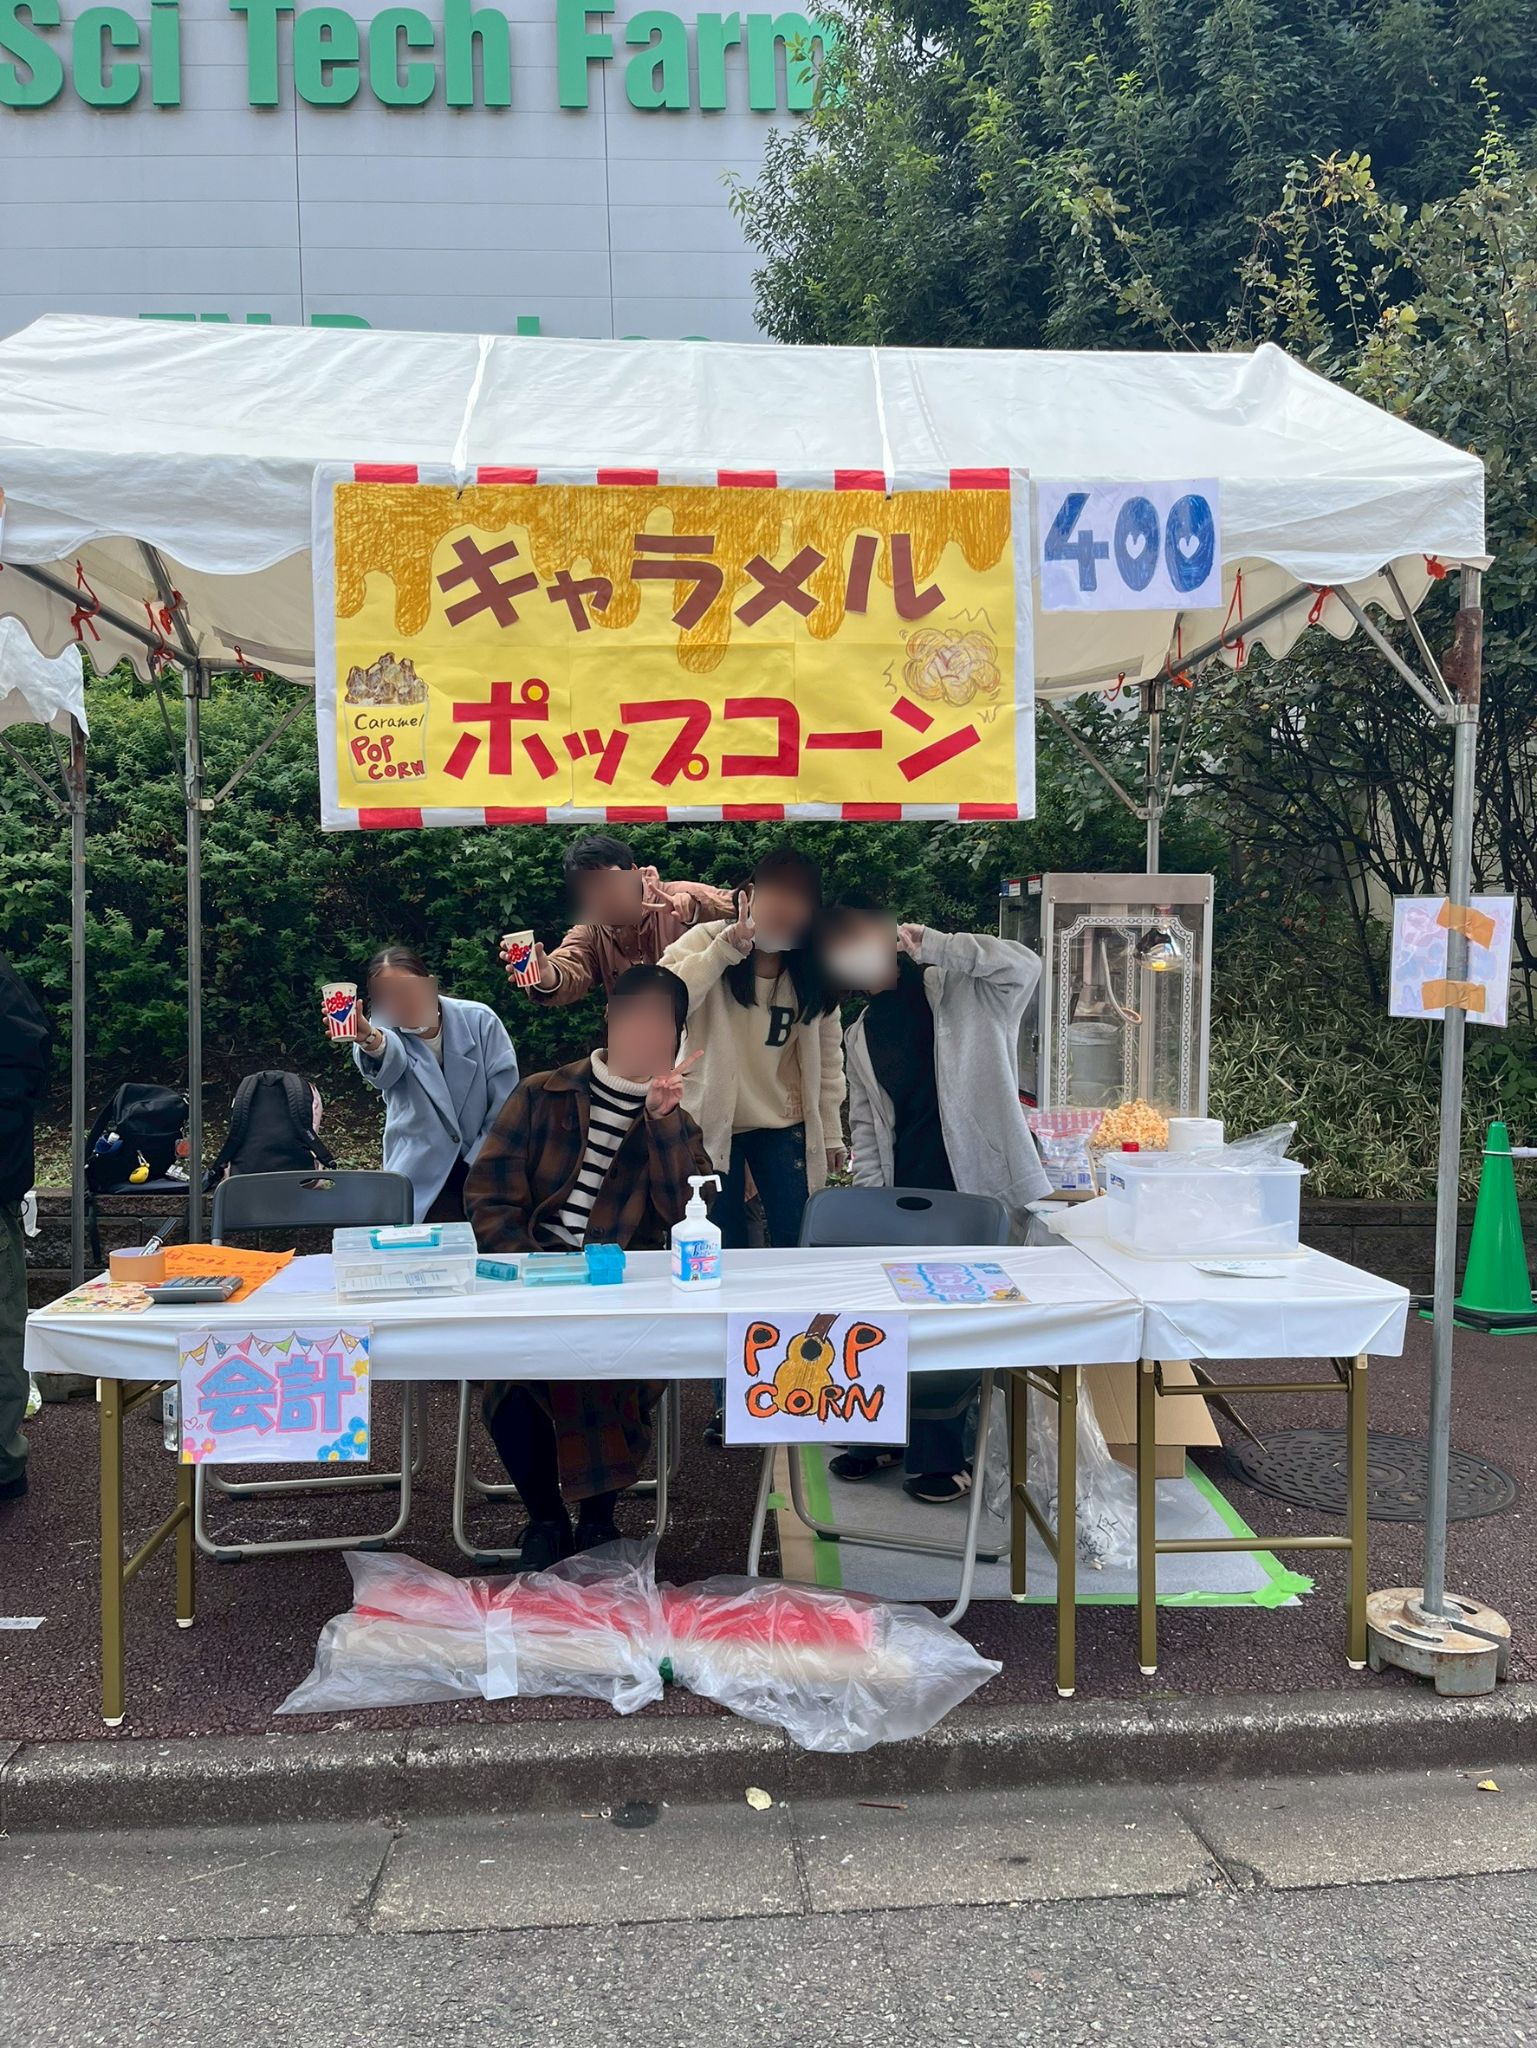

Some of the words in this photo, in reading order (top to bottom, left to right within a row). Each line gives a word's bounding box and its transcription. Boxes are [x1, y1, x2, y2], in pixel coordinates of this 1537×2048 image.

[0, 0, 182, 107] Sci
[229, 0, 512, 107] Tech
[556, 0, 848, 112] Farm
[1044, 492, 1215, 594] 400
[436, 532, 946, 632] キャラメル
[350, 734, 395, 766] POP
[354, 713, 425, 730] Caramel
[443, 678, 981, 789] ポップコーン
[368, 759, 426, 781] CORN
[765, 1005, 795, 1047] B
[197, 1353, 359, 1437] 会計
[745, 1381, 885, 1424] CORN
